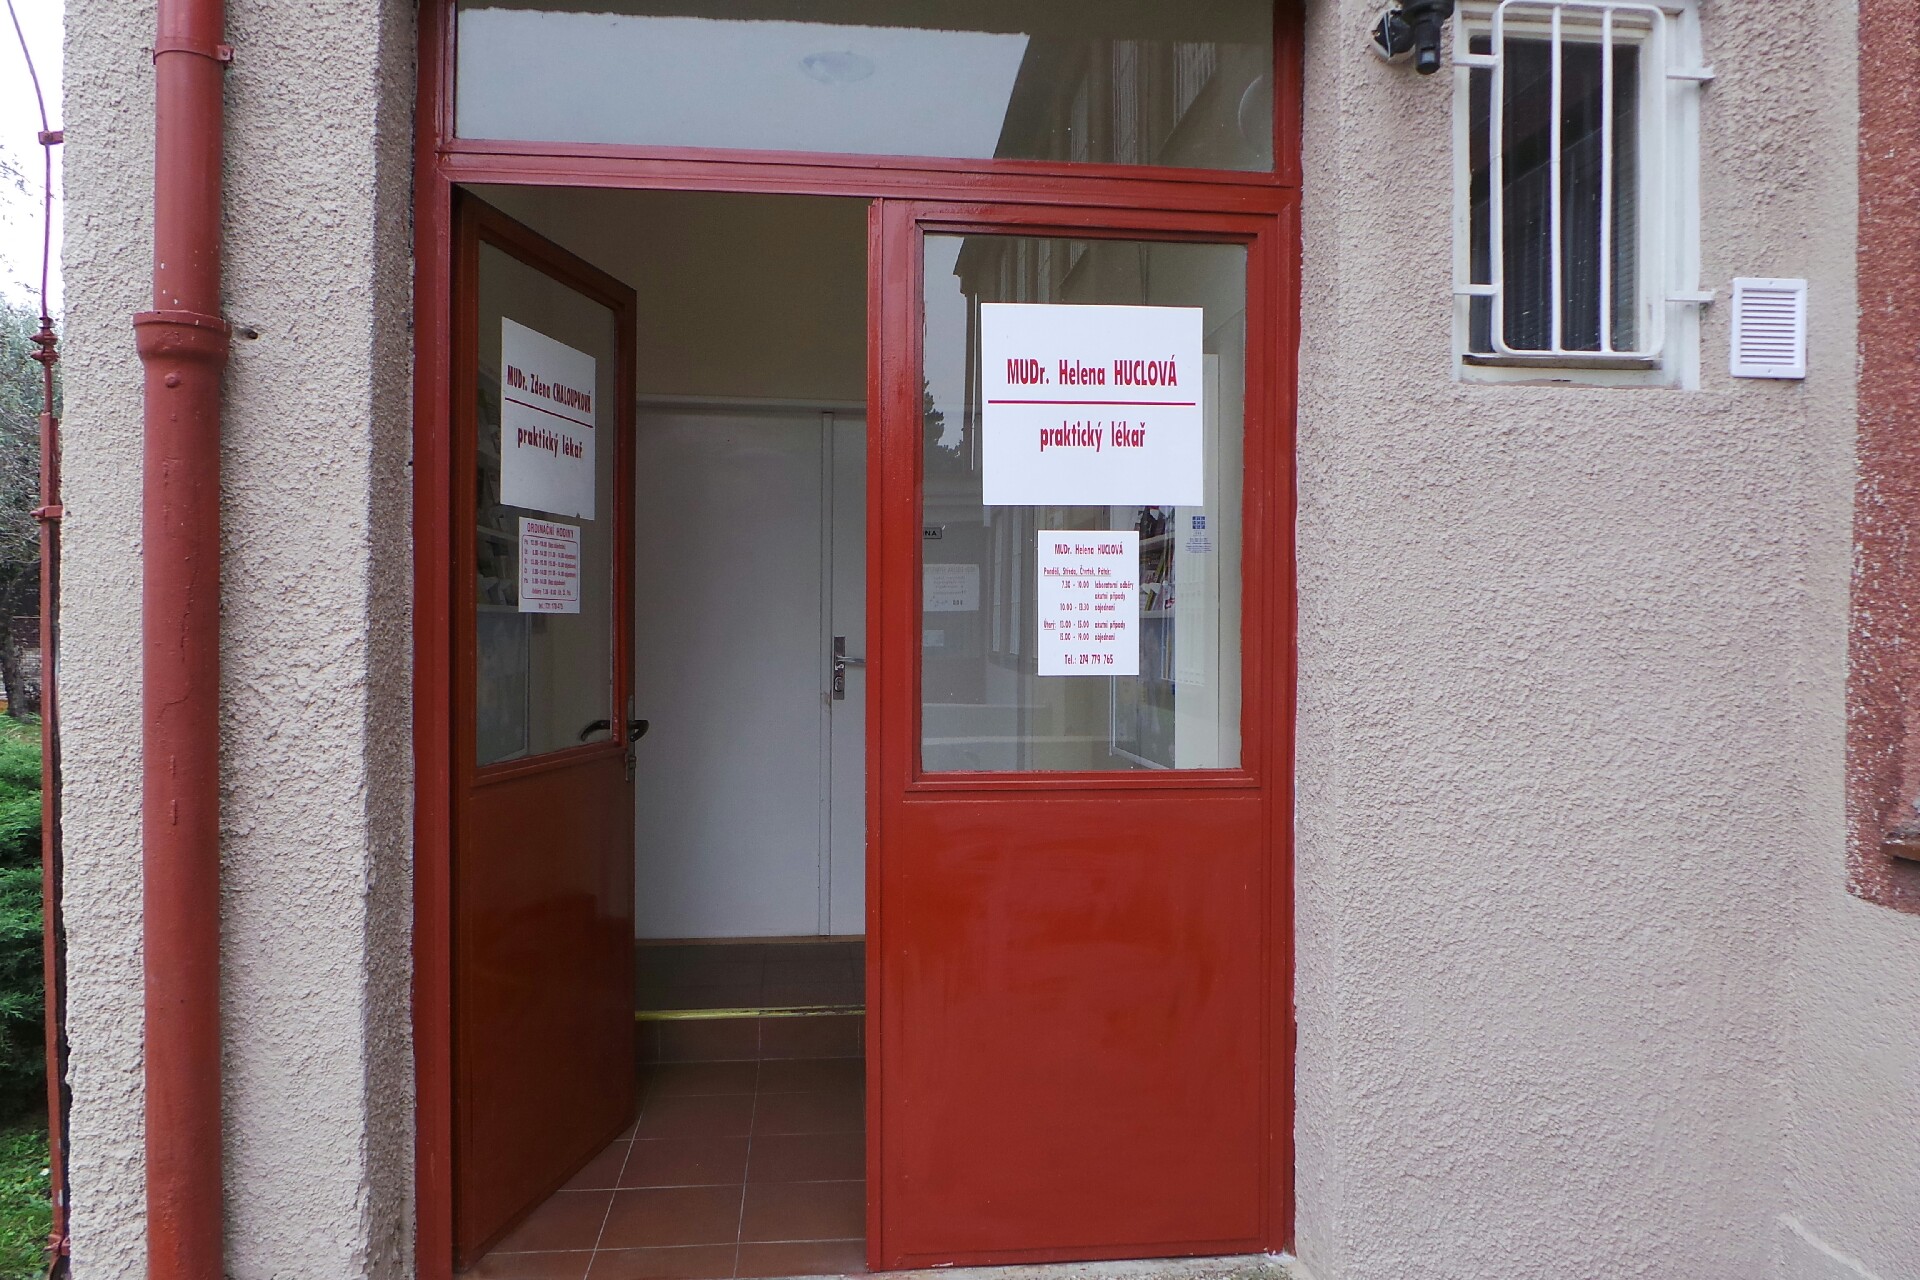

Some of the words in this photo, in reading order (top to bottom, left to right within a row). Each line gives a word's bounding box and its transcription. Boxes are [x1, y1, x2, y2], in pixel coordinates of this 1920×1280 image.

[1007, 358, 1050, 384] MUDr.
[1058, 359, 1106, 386] Helena
[1114, 354, 1178, 386] HUCLOVÁ
[506, 365, 528, 391] MUDr.
[530, 374, 551, 399] Zdena
[553, 382, 592, 413] CHALOUPKOVÁ
[517, 426, 559, 458] praktický
[562, 434, 583, 459] lékař
[1040, 420, 1103, 452] praktický
[1111, 420, 1146, 448] lékař
[528, 522, 554, 536] ORDINAČNÍ
[557, 527, 574, 538] HODINY
[1055, 544, 1072, 555] MUDr.
[1076, 544, 1094, 555] Helena
[1098, 541, 1124, 555] HUCLOVÁ
[1065, 654, 1076, 665] Tel.:
[1092, 654, 1100, 665] 779
[1104, 654, 1114, 665] 765
